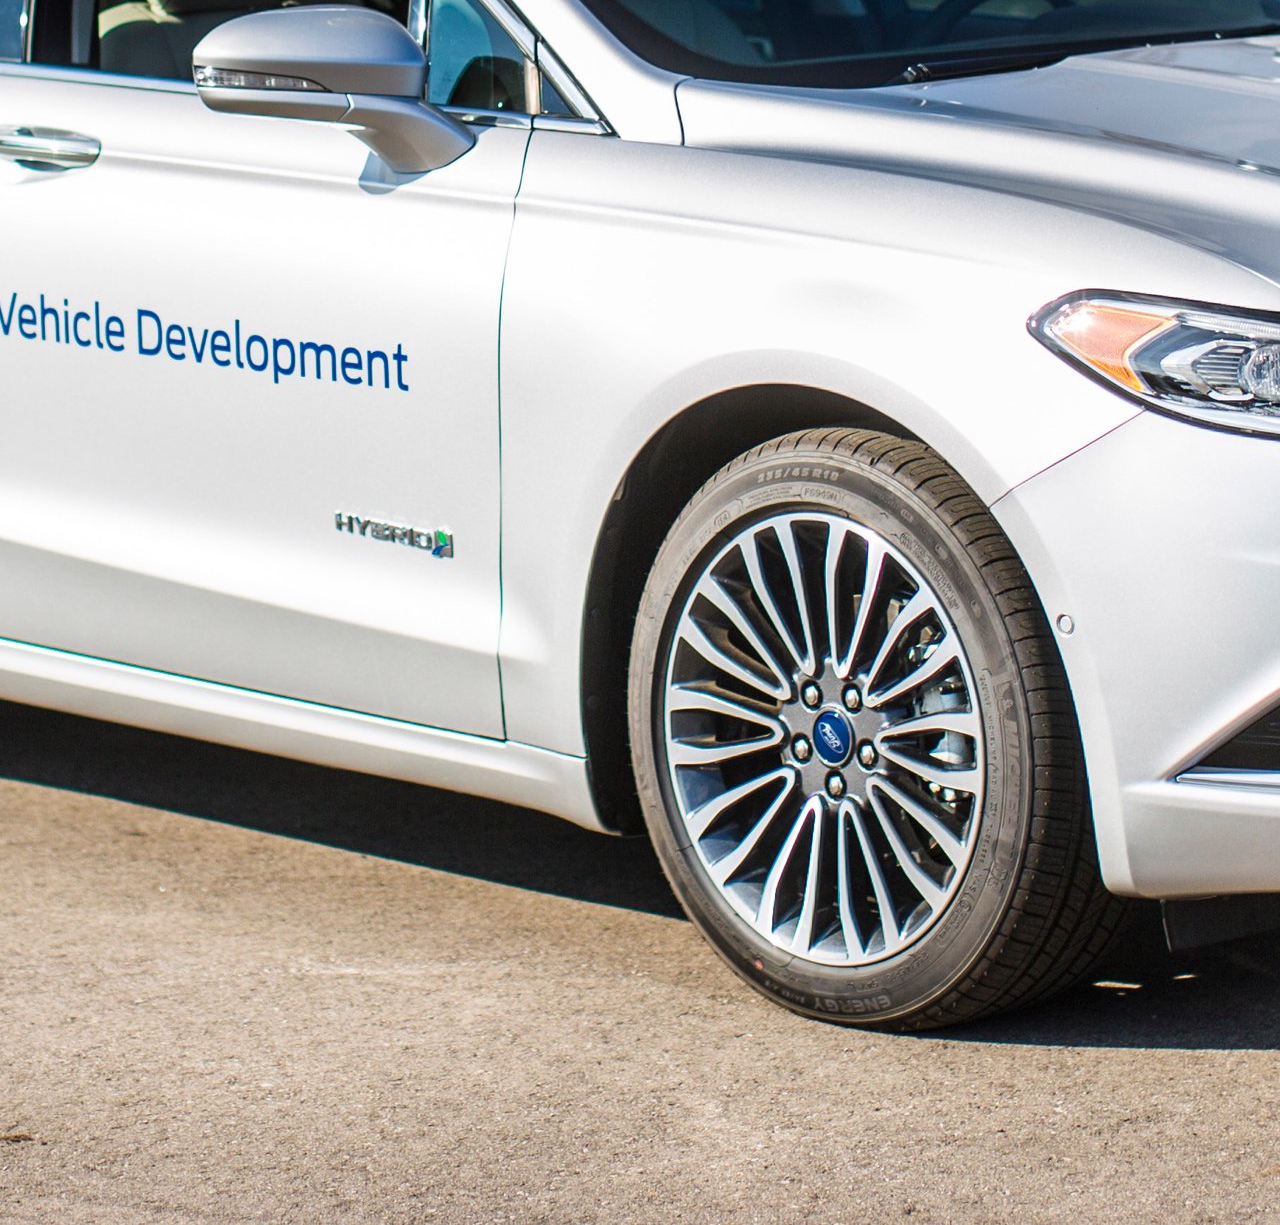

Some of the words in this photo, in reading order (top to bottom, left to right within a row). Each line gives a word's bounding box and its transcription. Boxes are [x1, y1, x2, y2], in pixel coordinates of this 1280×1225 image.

[136, 309, 409, 392] Development
[335, 511, 433, 551] HYBRID
[814, 994, 892, 1013] ENERGY
